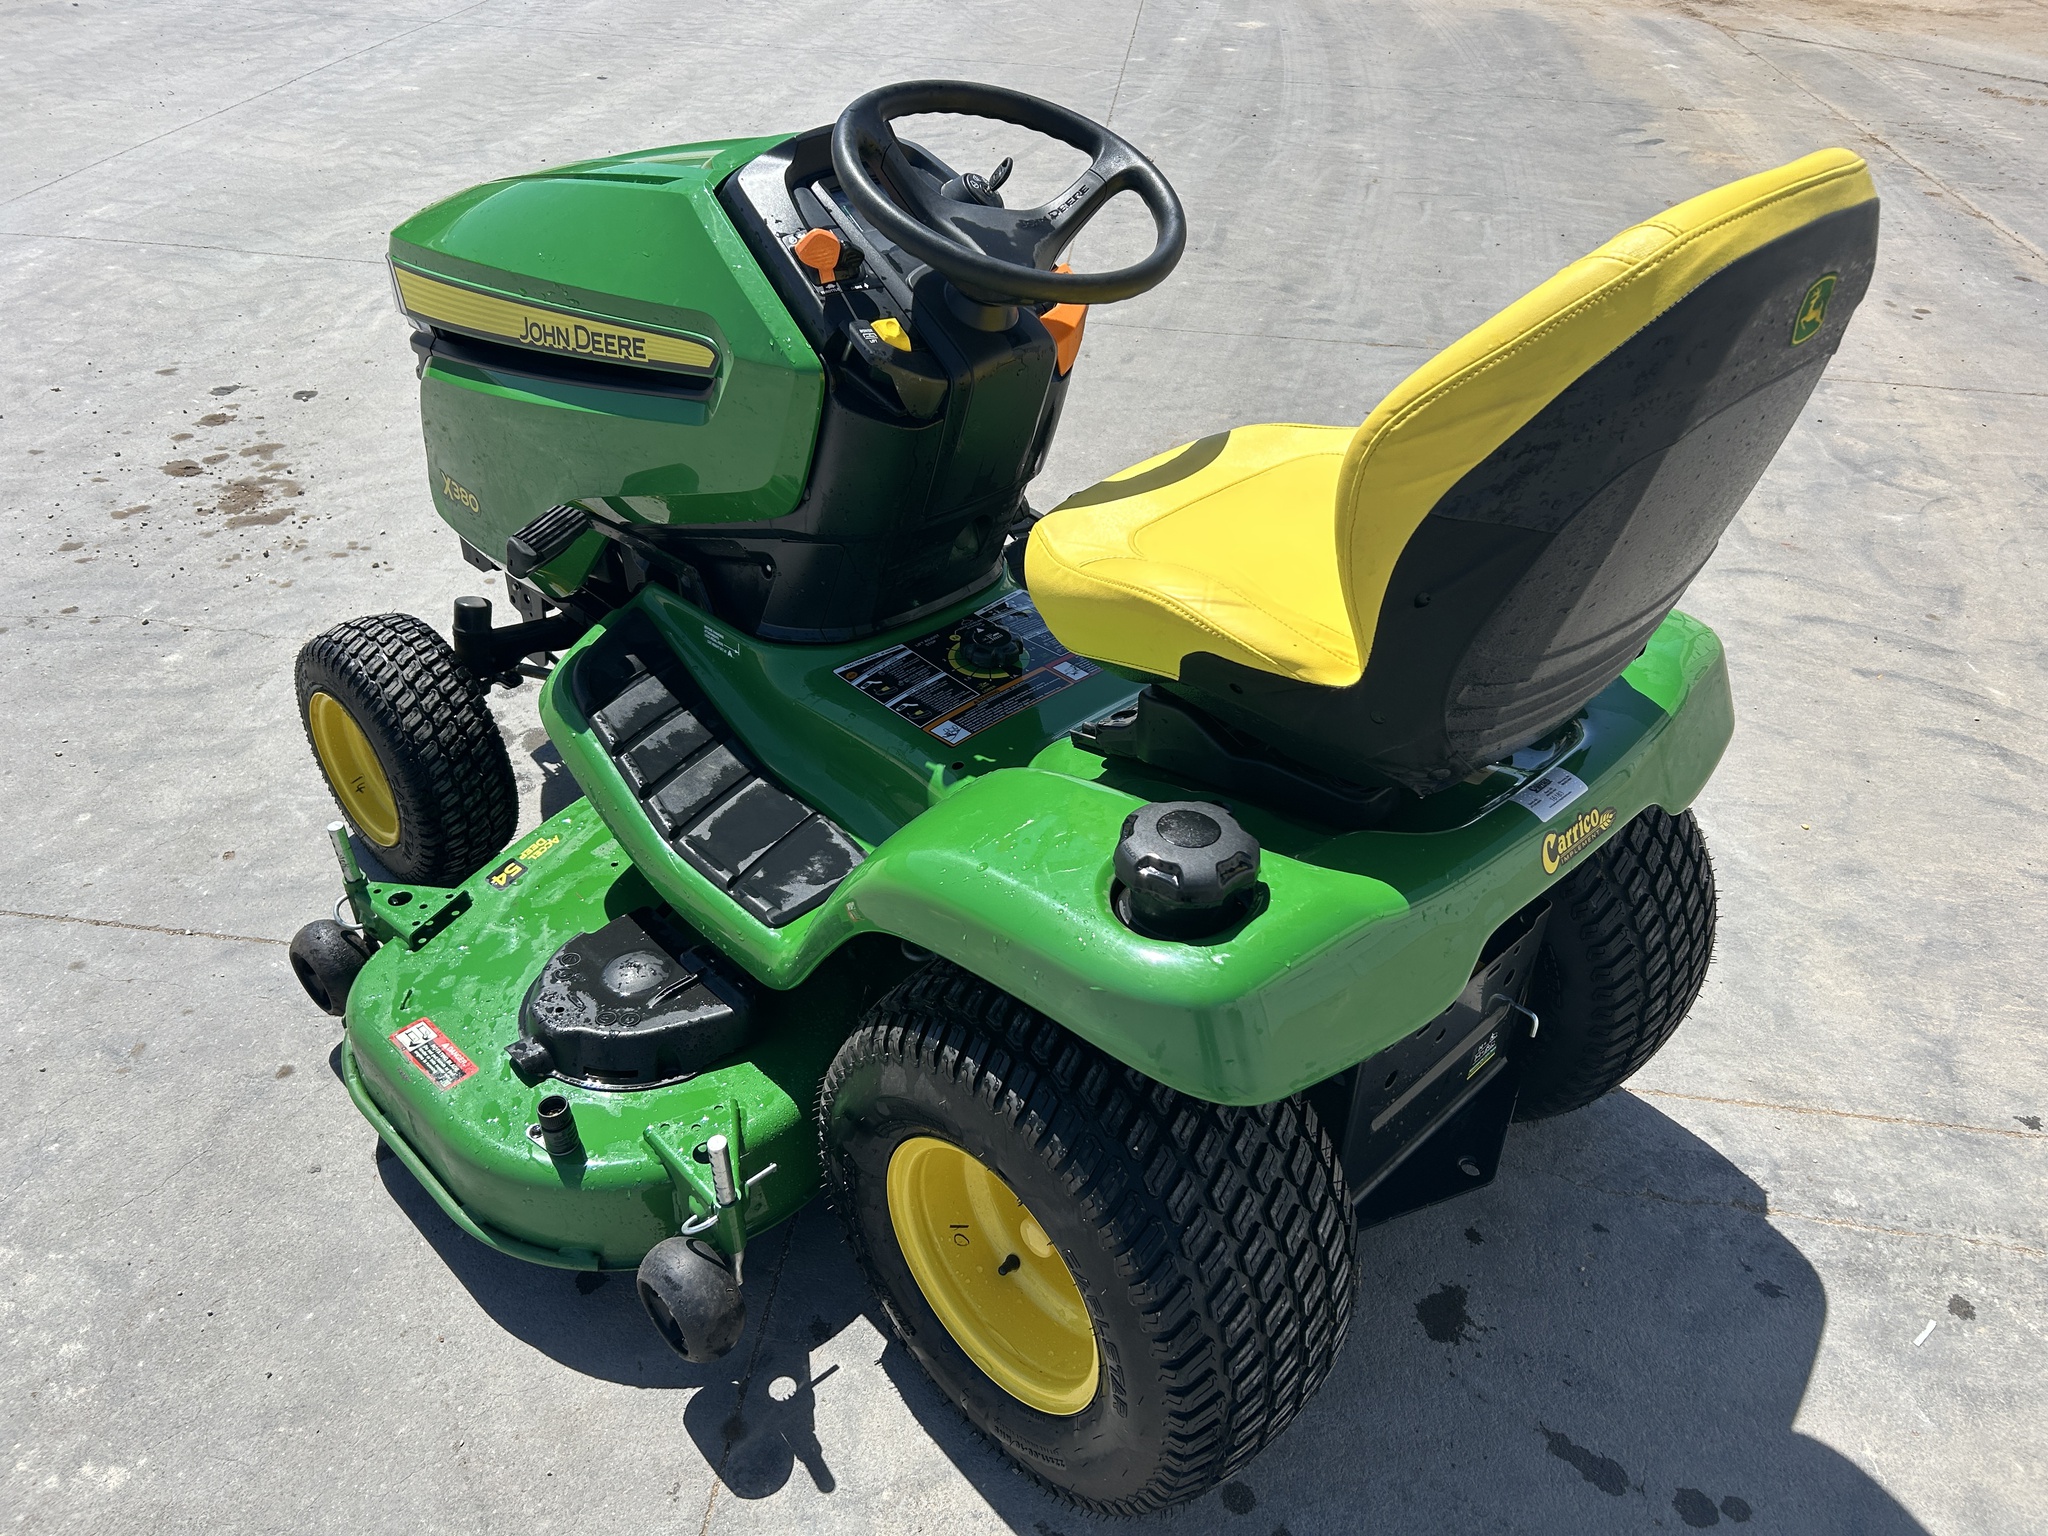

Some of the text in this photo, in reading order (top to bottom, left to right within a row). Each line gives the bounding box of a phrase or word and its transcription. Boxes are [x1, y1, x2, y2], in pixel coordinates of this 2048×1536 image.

[1048, 184, 1090, 220] DEERE
[520, 316, 648, 361] JOHN DEERE
[440, 469, 480, 513] X380
[519, 837, 547, 860] DEEP
[528, 835, 560, 860] ACCEL
[1542, 809, 1600, 874] Carrico
[1561, 831, 1600, 865] IMPLEMENT
[491, 862, 522, 886] 54
[949, 1224, 970, 1246] 10
